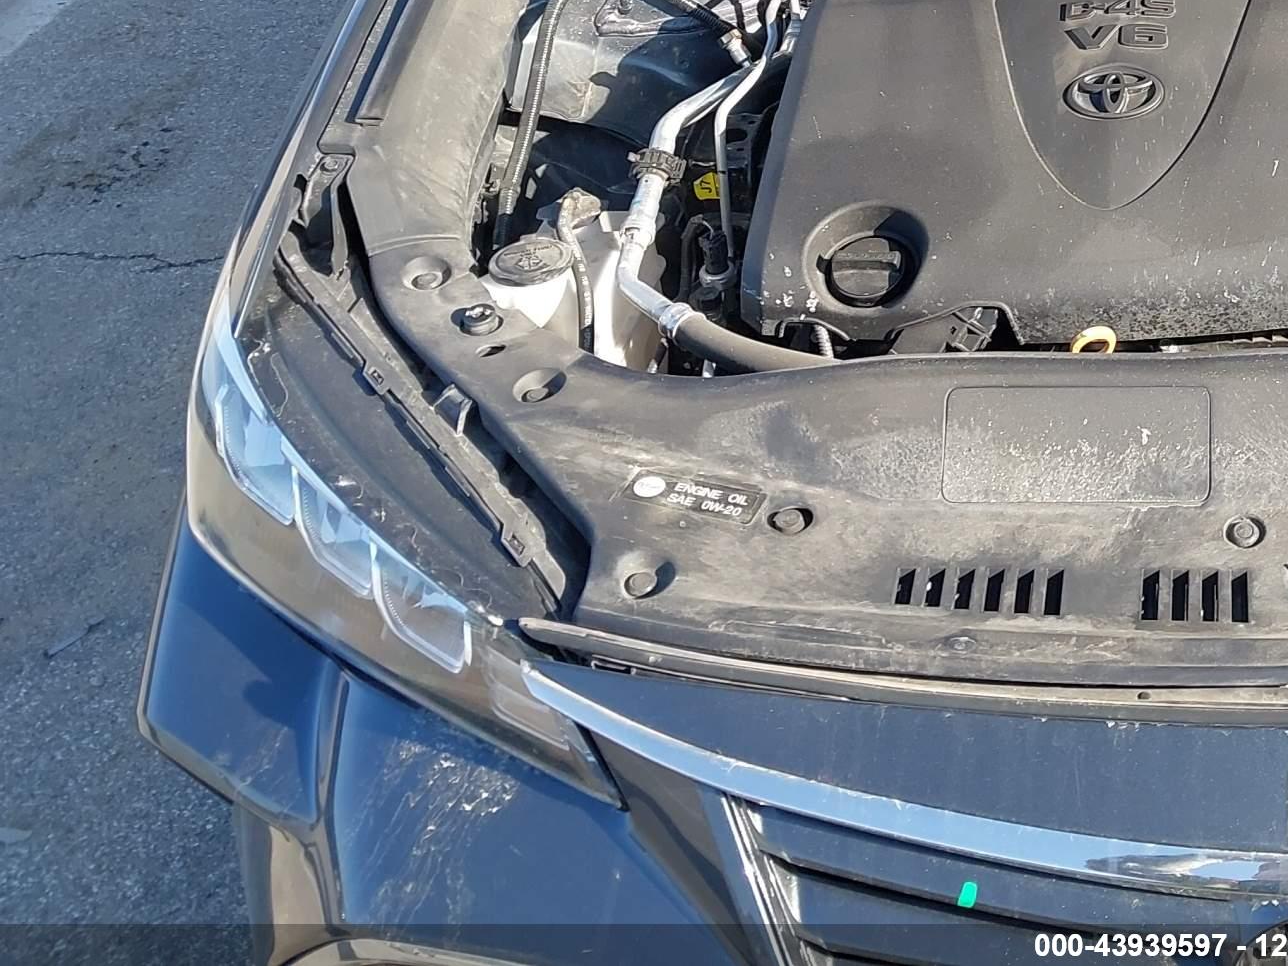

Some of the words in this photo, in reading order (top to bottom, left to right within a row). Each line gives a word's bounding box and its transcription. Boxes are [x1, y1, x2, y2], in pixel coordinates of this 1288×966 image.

[1064, 23, 1168, 50] V6
[666, 493, 697, 507] SAE
[700, 501, 743, 517] 0W-20
[673, 482, 724, 500] ENGINE
[728, 493, 748, 506] OIL
